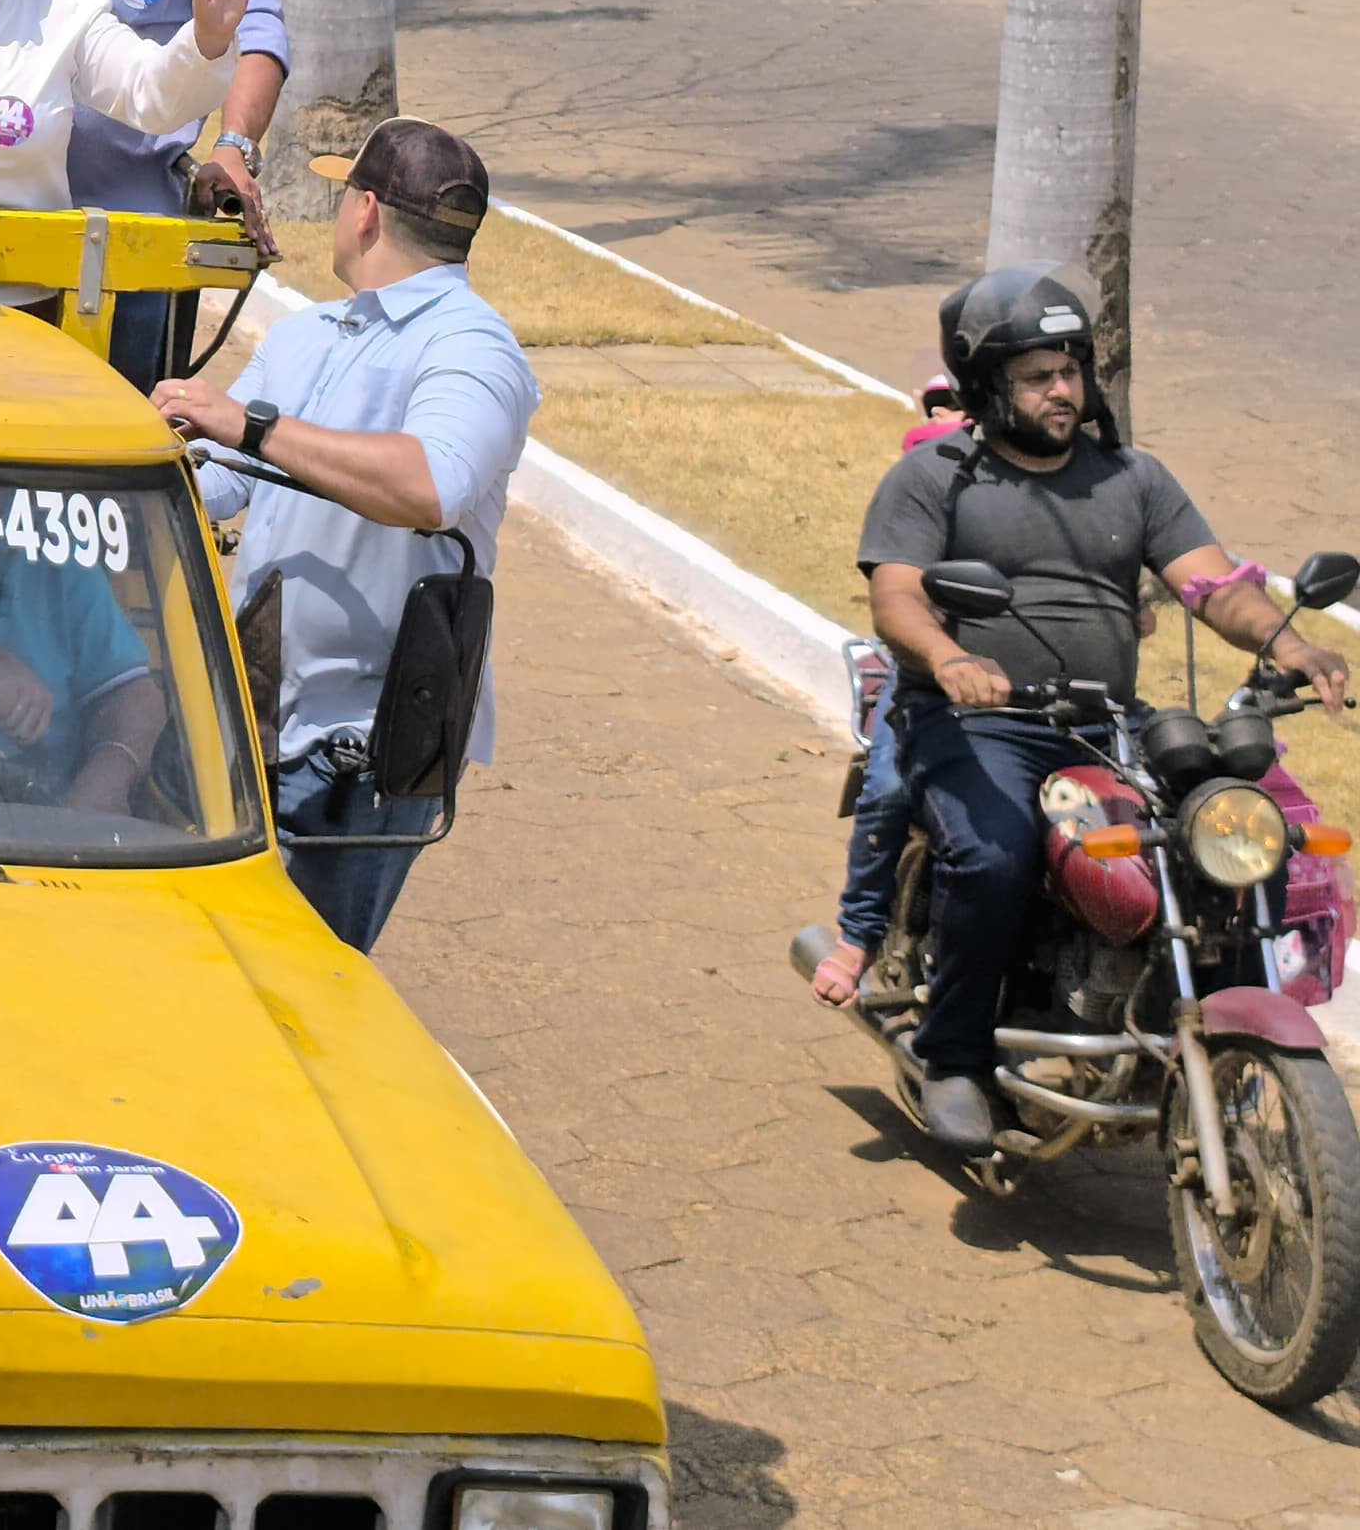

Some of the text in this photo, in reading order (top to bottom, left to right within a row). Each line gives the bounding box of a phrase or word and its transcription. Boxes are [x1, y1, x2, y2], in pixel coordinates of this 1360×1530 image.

[44, 1151, 96, 1164] amo
[105, 1164, 166, 1174] Jardim
[7, 1173, 221, 1278] 44
[128, 1287, 178, 1308] BRASIL
